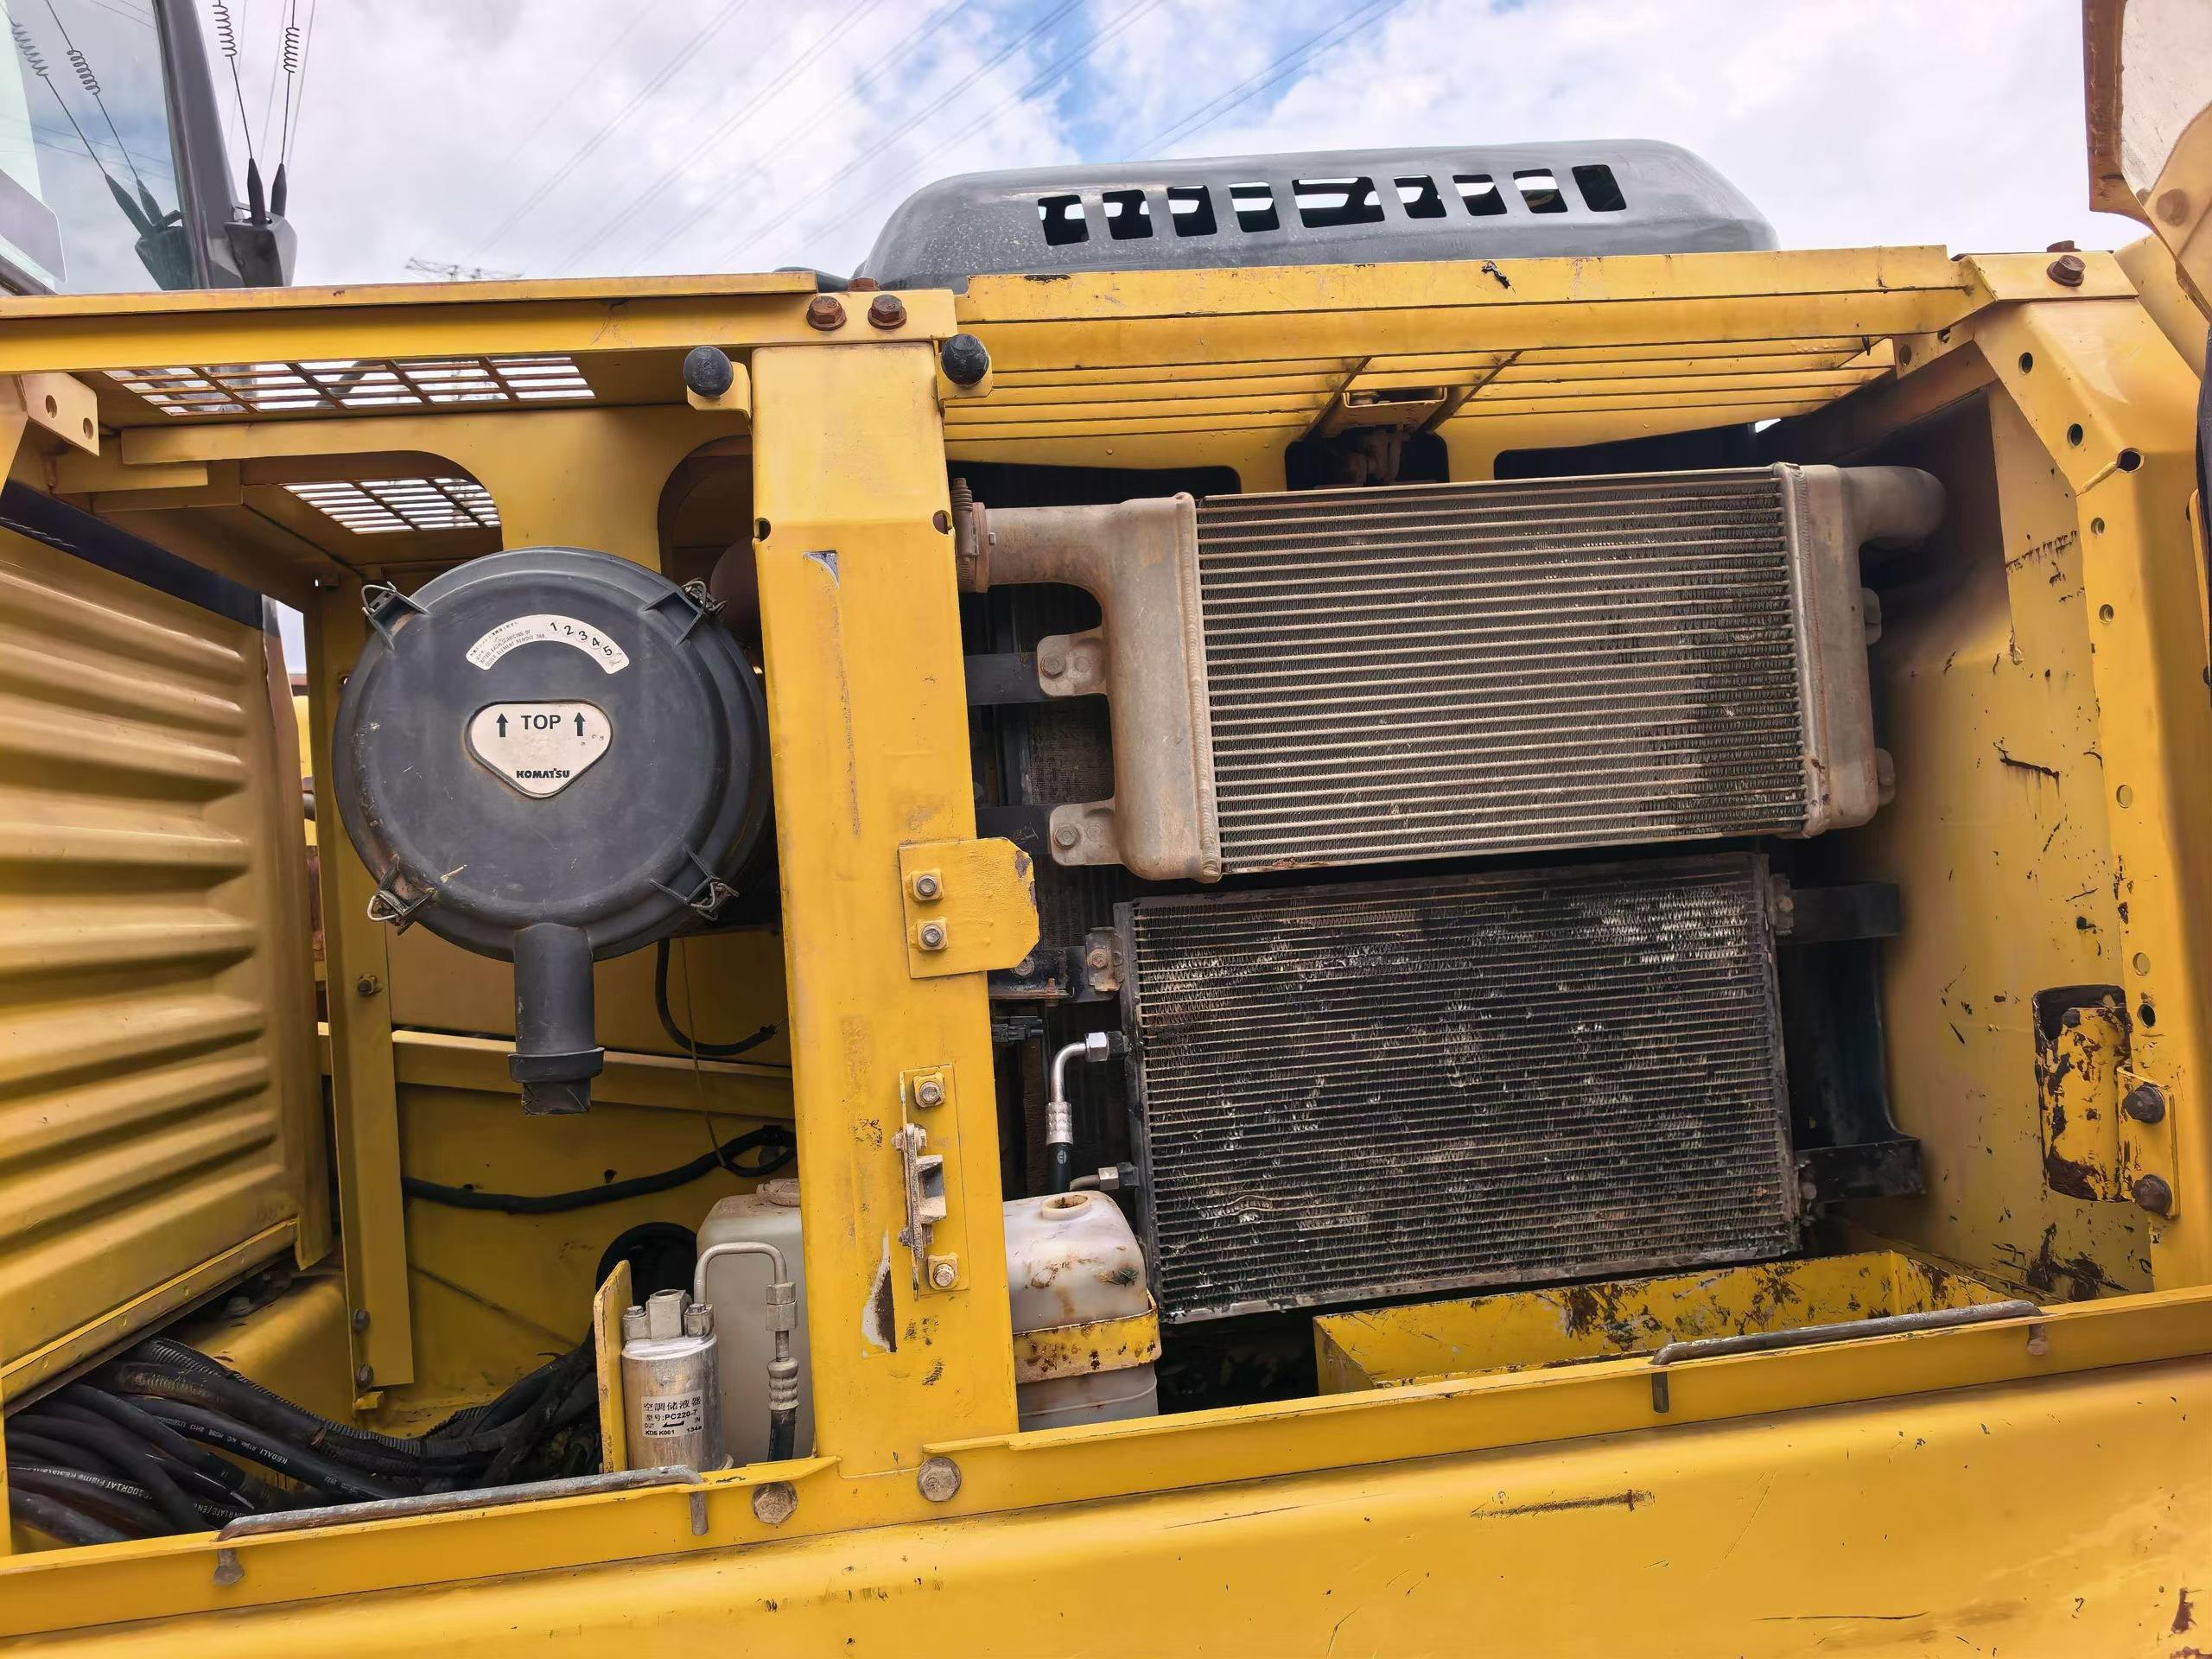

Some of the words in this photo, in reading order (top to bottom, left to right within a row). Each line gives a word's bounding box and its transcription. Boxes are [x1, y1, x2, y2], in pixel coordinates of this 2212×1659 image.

[550, 622, 557, 632] 1
[563, 625, 575, 636] 2
[578, 630, 588, 641] 3
[592, 637, 601, 646] 4
[603, 645, 613, 656] 5
[520, 714, 562, 730] TOP
[516, 768, 570, 779] KOMATSU
